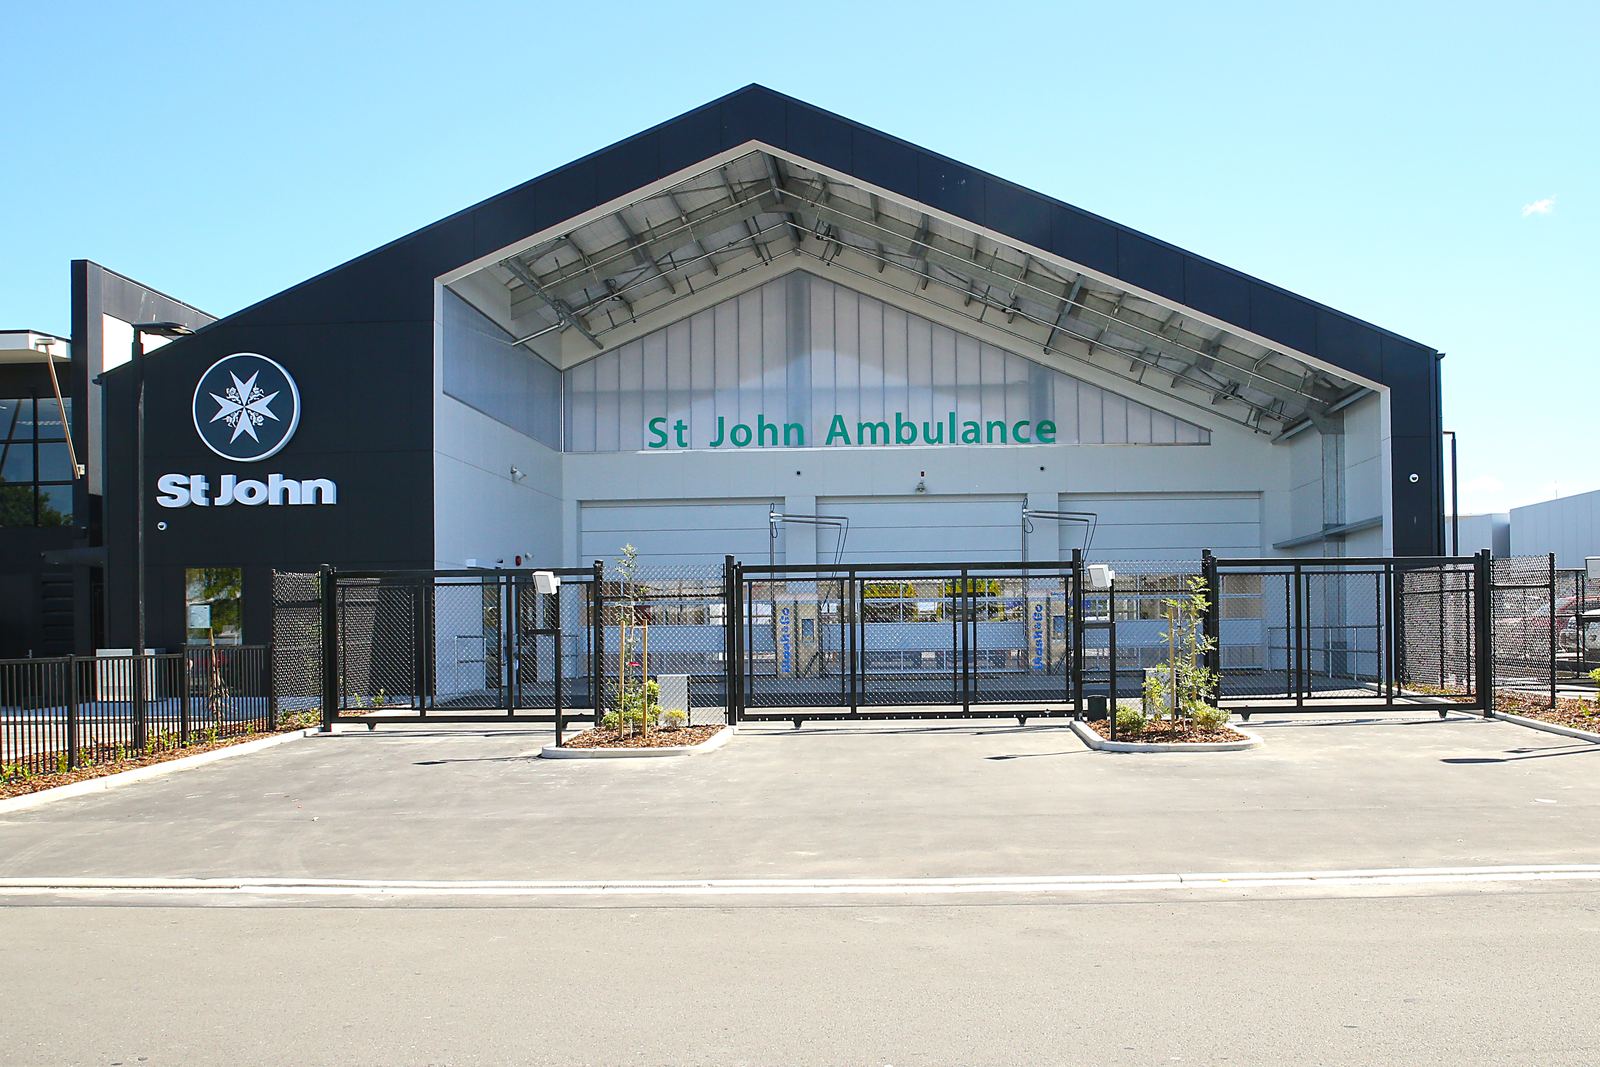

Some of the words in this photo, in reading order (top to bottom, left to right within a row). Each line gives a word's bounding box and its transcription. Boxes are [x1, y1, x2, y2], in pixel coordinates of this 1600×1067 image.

[646, 416, 688, 448] St
[709, 413, 806, 447] John
[825, 411, 1056, 446] Ambulance
[156, 473, 209, 508] St
[214, 473, 337, 506] John
